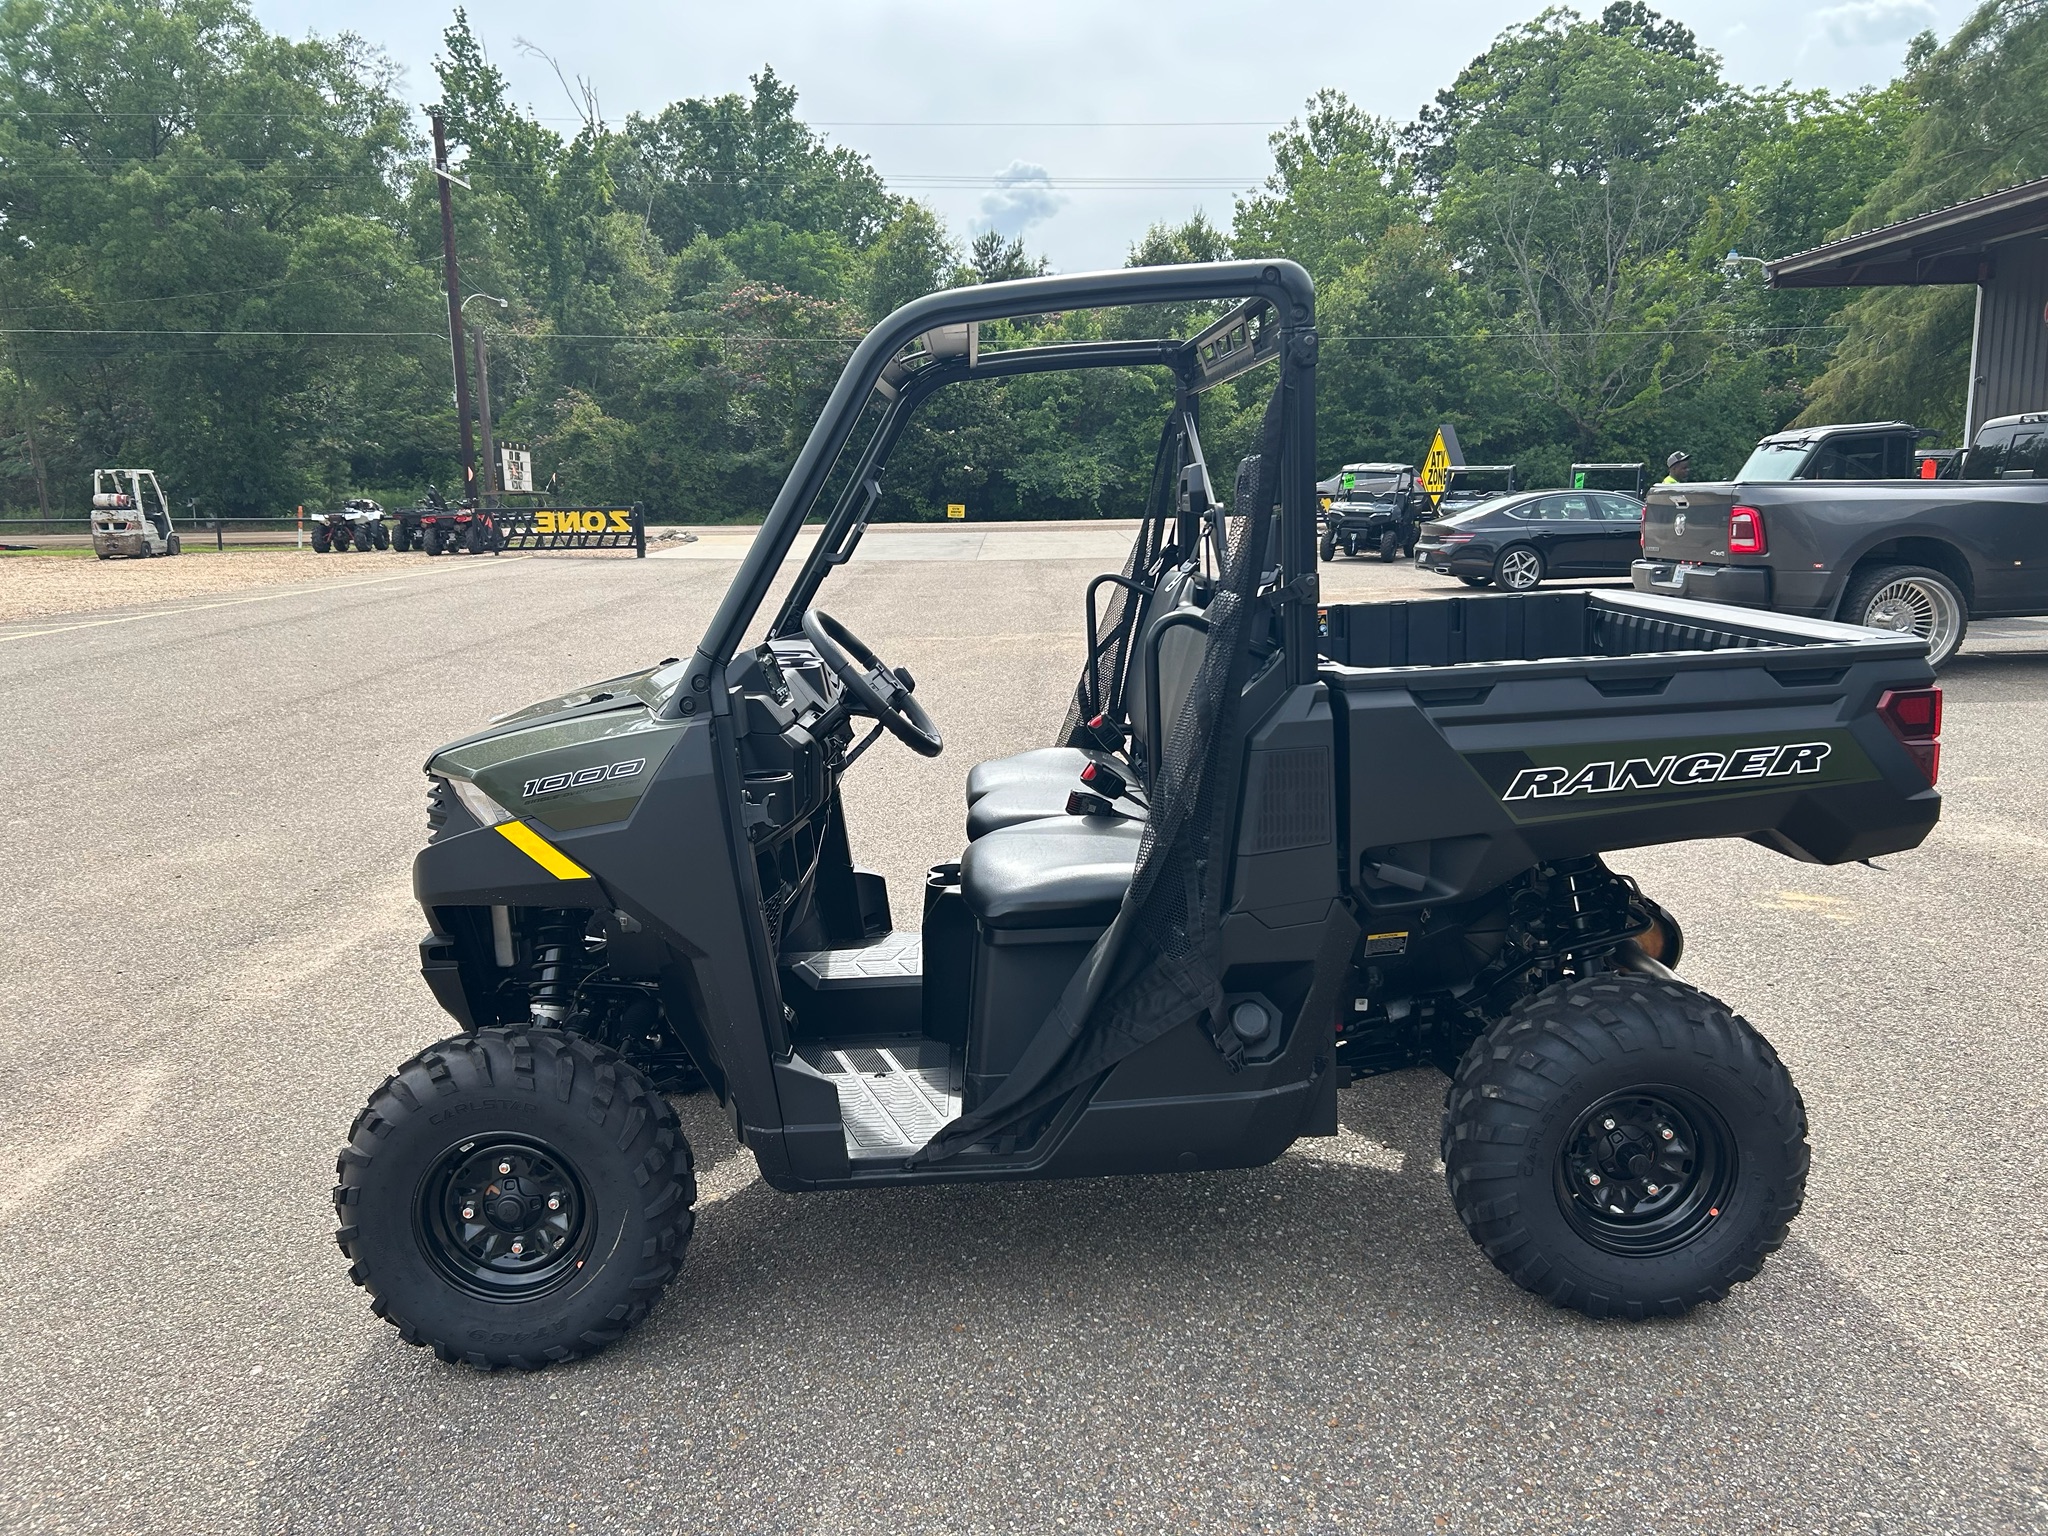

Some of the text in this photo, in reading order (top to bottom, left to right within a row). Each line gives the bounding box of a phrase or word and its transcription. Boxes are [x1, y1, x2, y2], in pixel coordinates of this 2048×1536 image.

[1430, 450, 1446, 468] ATV
[1427, 467, 1447, 486] ZONE
[522, 757, 646, 797] 1000
[1501, 741, 1832, 801] RANGER
[523, 778, 641, 806] SINGLE OVERHEAD CAM
[428, 1098, 539, 1126] CARLSTAR
[1522, 1079, 1585, 1177] CARLSTAR
[466, 1314, 569, 1345] AT489
